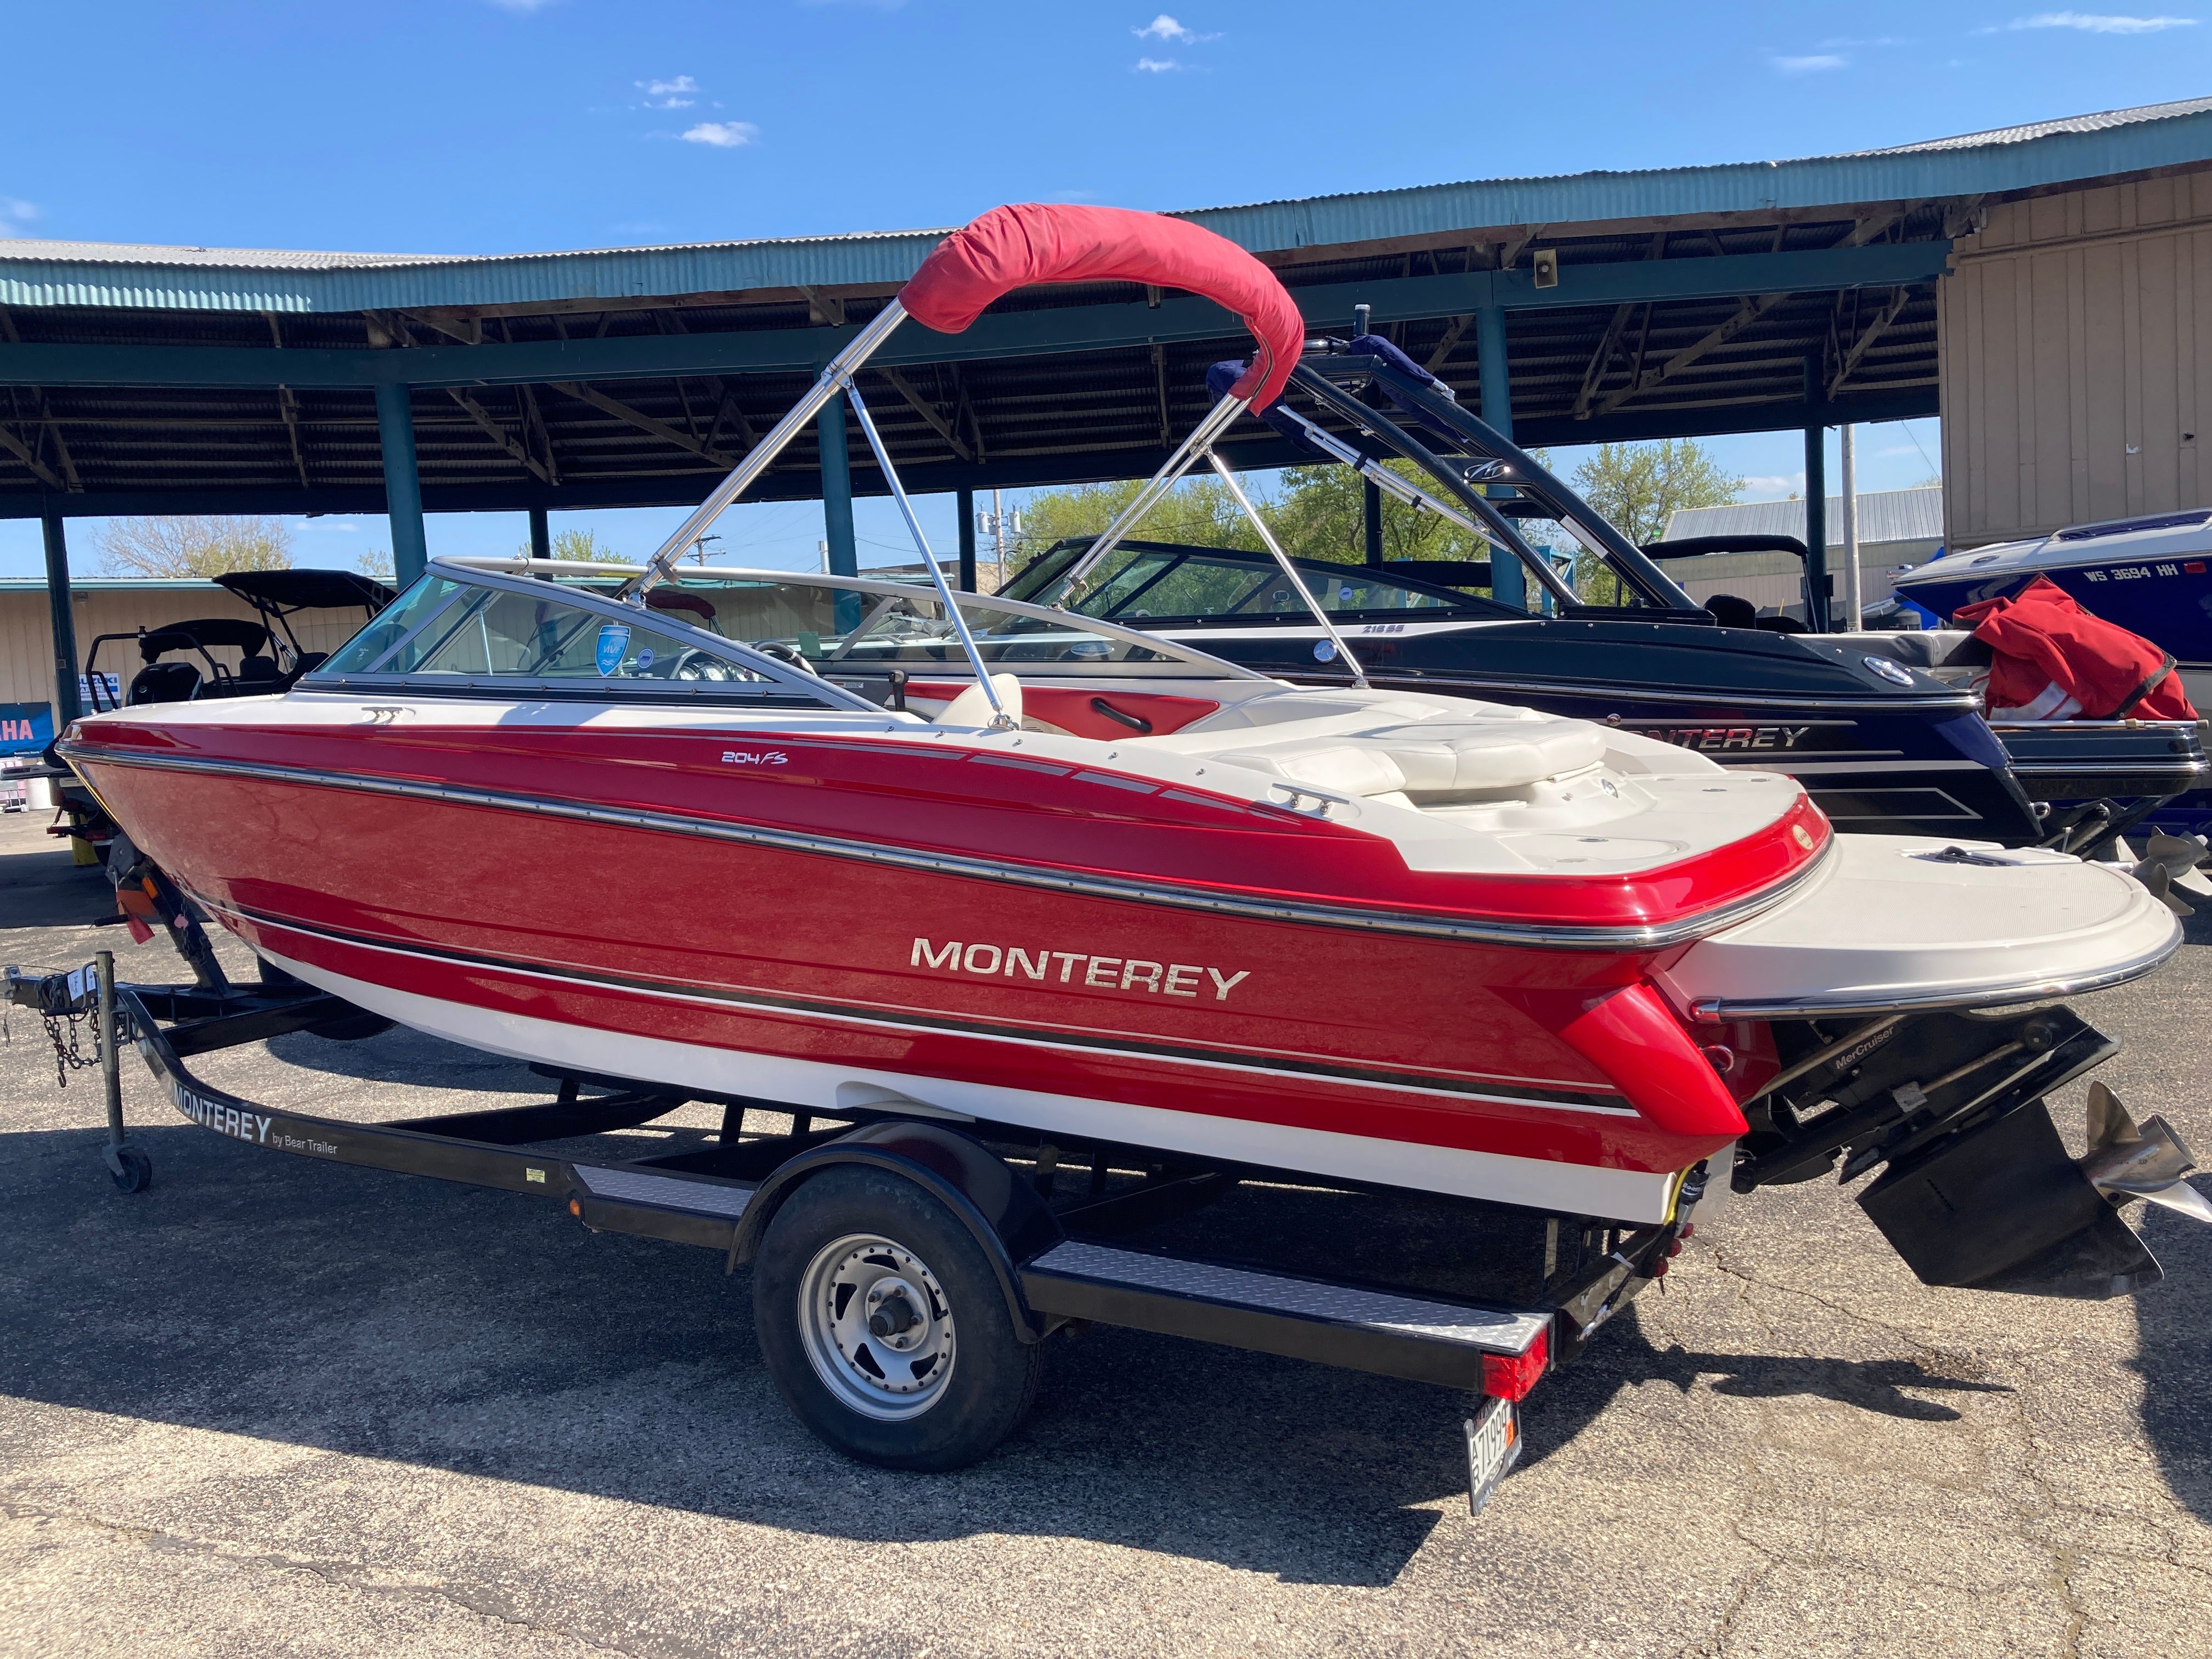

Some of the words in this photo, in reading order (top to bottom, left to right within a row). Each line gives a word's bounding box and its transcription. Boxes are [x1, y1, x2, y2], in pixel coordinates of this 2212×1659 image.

[2084, 571, 2108, 582] WS
[2111, 567, 2151, 580] 3694
[2156, 563, 2179, 576] HH
[0, 719, 33, 741] HA
[1626, 727, 1810, 748] NTEREY
[910, 937, 1251, 1001] MONTEREY
[1835, 1026, 1894, 1069] MerCruiser
[174, 1083, 272, 1143] MONTEREY
[272, 1133, 283, 1148] by
[285, 1135, 306, 1150] Bear
[307, 1139, 338, 1155] Trailer
[1479, 1403, 1507, 1474] 71999
